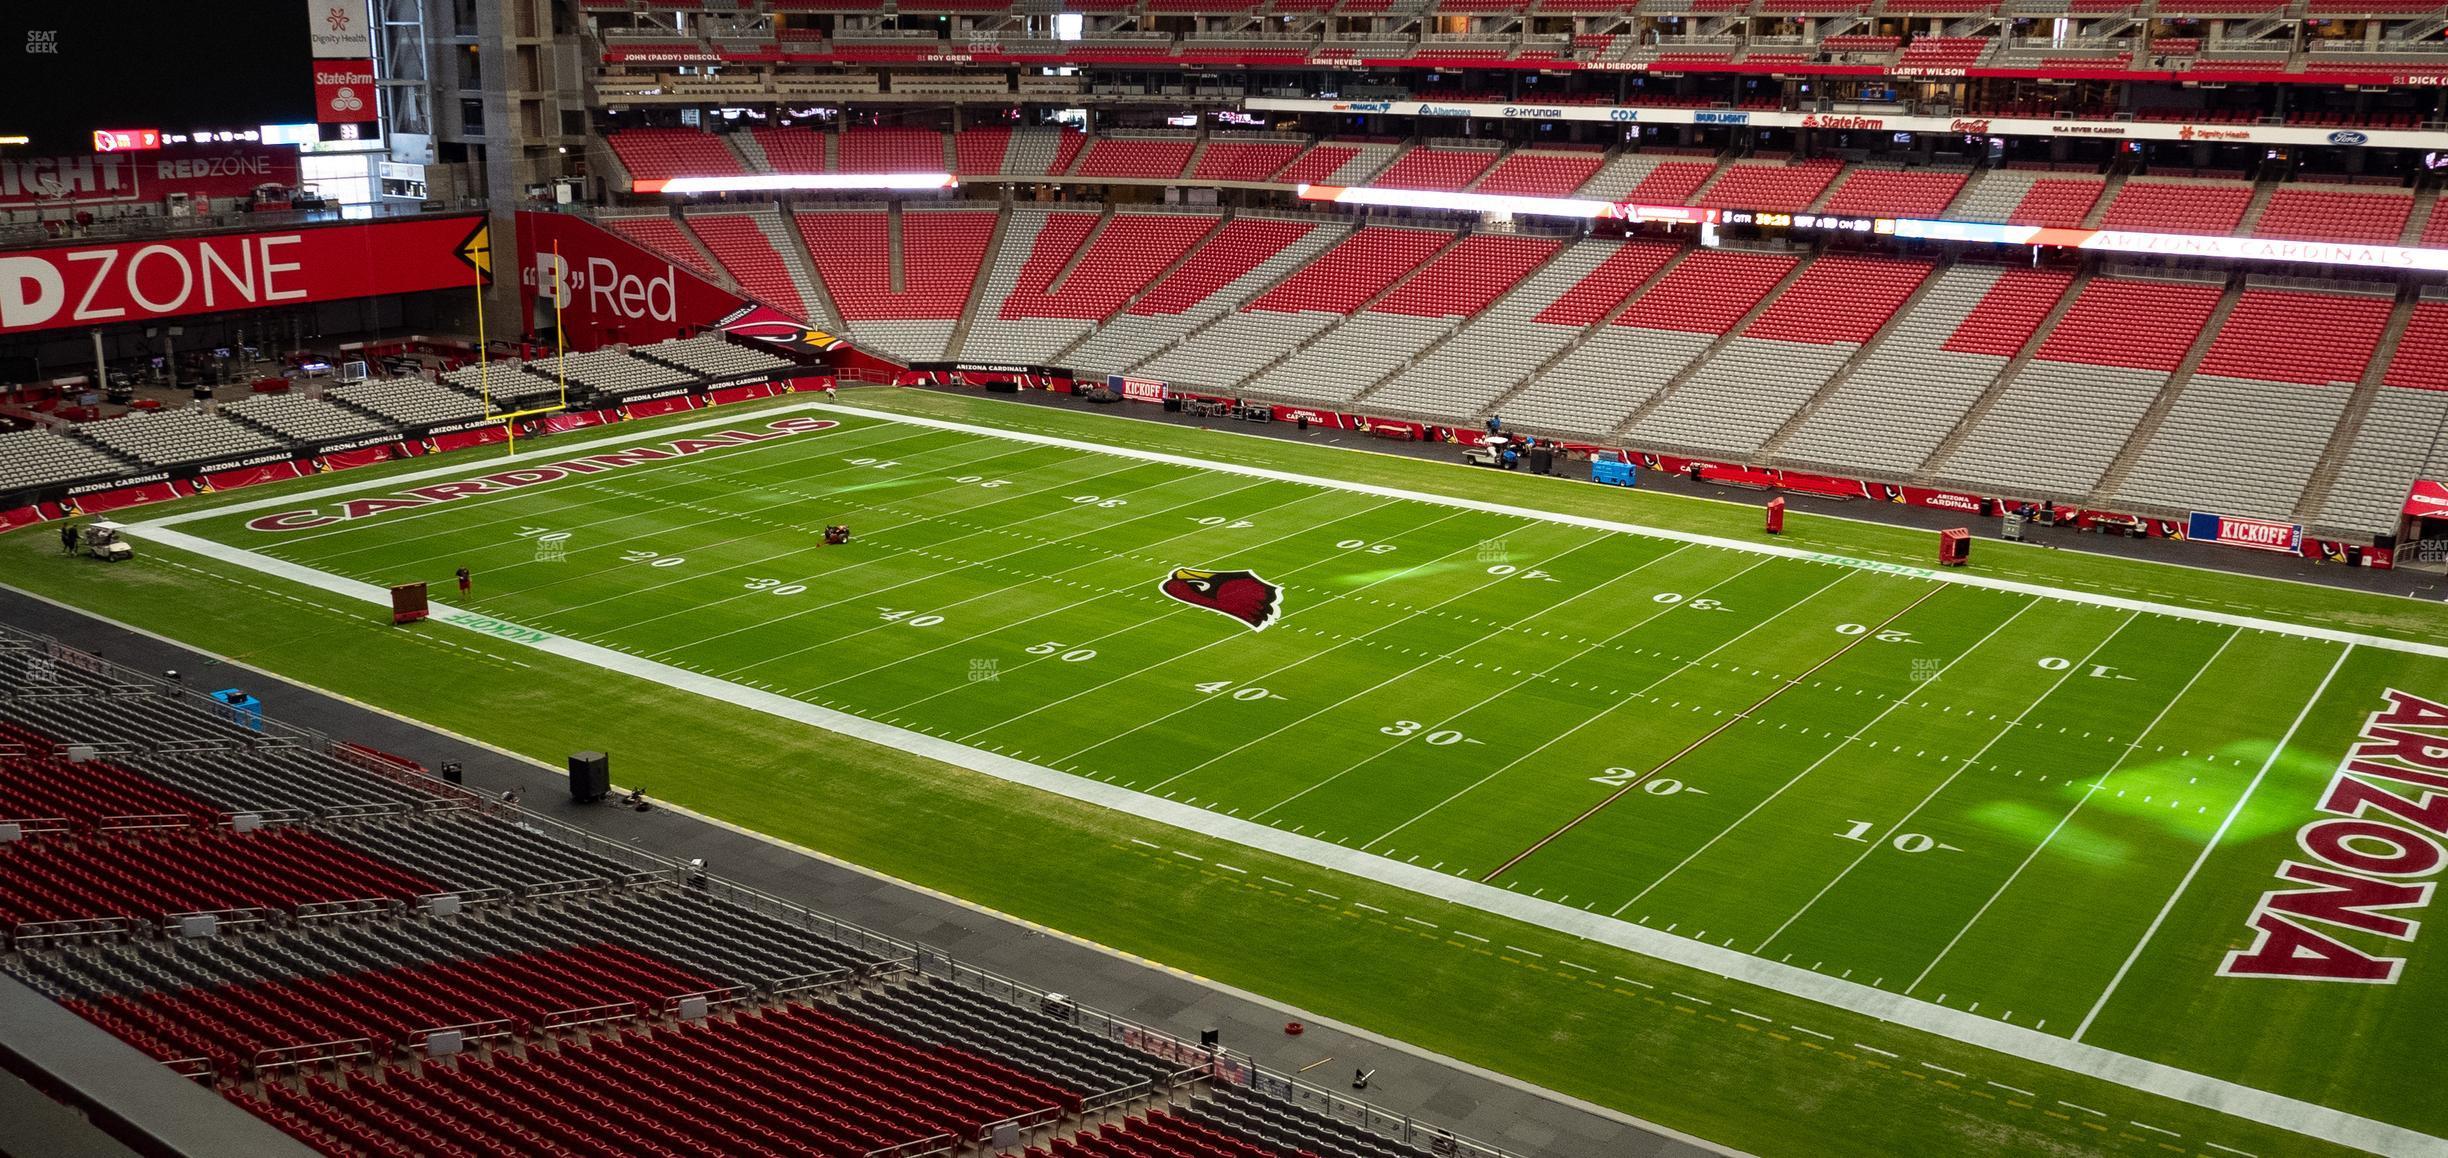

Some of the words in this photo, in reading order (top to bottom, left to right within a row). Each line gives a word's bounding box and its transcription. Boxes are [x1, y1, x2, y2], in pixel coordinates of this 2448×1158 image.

[312, 34, 341, 45] Dignity
[342, 34, 367, 43] Health
[648, 53, 682, 62] (PADDY)
[1312, 58, 1333, 66] ERNIE
[1587, 62, 1605, 70] DAN
[1891, 67, 1924, 76] LARRY
[1925, 68, 1966, 76] WILSON
[2392, 75, 2407, 85] 81
[2409, 76, 2437, 85] DICK
[1519, 108, 1562, 118] HYUNDAI
[1610, 109, 1638, 121] COX
[1695, 113, 1716, 123] BUD
[1717, 113, 1748, 124] LIGHT
[2197, 129, 2224, 141] Dignity
[2225, 129, 2250, 140] Health
[2332, 131, 2362, 144] Ford
[2097, 233, 2222, 255] ARIZONA
[2240, 242, 2415, 266] CARDINALS
[956, 364, 987, 372] ARIZONA
[708, 381, 734, 390] ARIZONA
[735, 375, 769, 387] CARDINALS
[1125, 381, 1160, 397] KICKOFF
[622, 394, 652, 404] ARIZONA
[653, 387, 689, 400] CARDINALS
[428, 423, 463, 435] ARIZONA
[464, 416, 507, 431] CARDINALS
[319, 441, 356, 454] ARIZONA
[357, 433, 404, 449] CARDINALS
[200, 460, 241, 474] ARIZONA
[242, 451, 292, 469] CARDINALS
[849, 457, 902, 470] 10
[246, 417, 841, 532] CARDINALS
[953, 476, 1013, 488] 20
[67, 482, 113, 495] ARIZONA
[115, 471, 170, 487] CARDINALS
[1071, 495, 1128, 509] 30
[1926, 498, 1979, 510] CARDINALS
[1937, 494, 1969, 503] ARIZONA
[1195, 516, 1255, 530] 40
[2221, 520, 2287, 545] KICKOFF
[1336, 539, 1397, 554] 50
[619, 553, 685, 568] 20
[1487, 564, 1549, 580] 40
[744, 579, 807, 596] 30
[1652, 592, 1722, 611] 30
[877, 609, 945, 628] 40
[444, 614, 547, 643] KICKOFF
[1835, 623, 1912, 643] 20
[1025, 641, 1098, 662] 50
[2037, 657, 2118, 679] 10
[1194, 680, 1270, 701] 40
[1380, 720, 1465, 746] 30
[1589, 767, 1683, 796] 20
[1833, 820, 1935, 853] 10
[2214, 687, 2448, 984] ARIZONA
